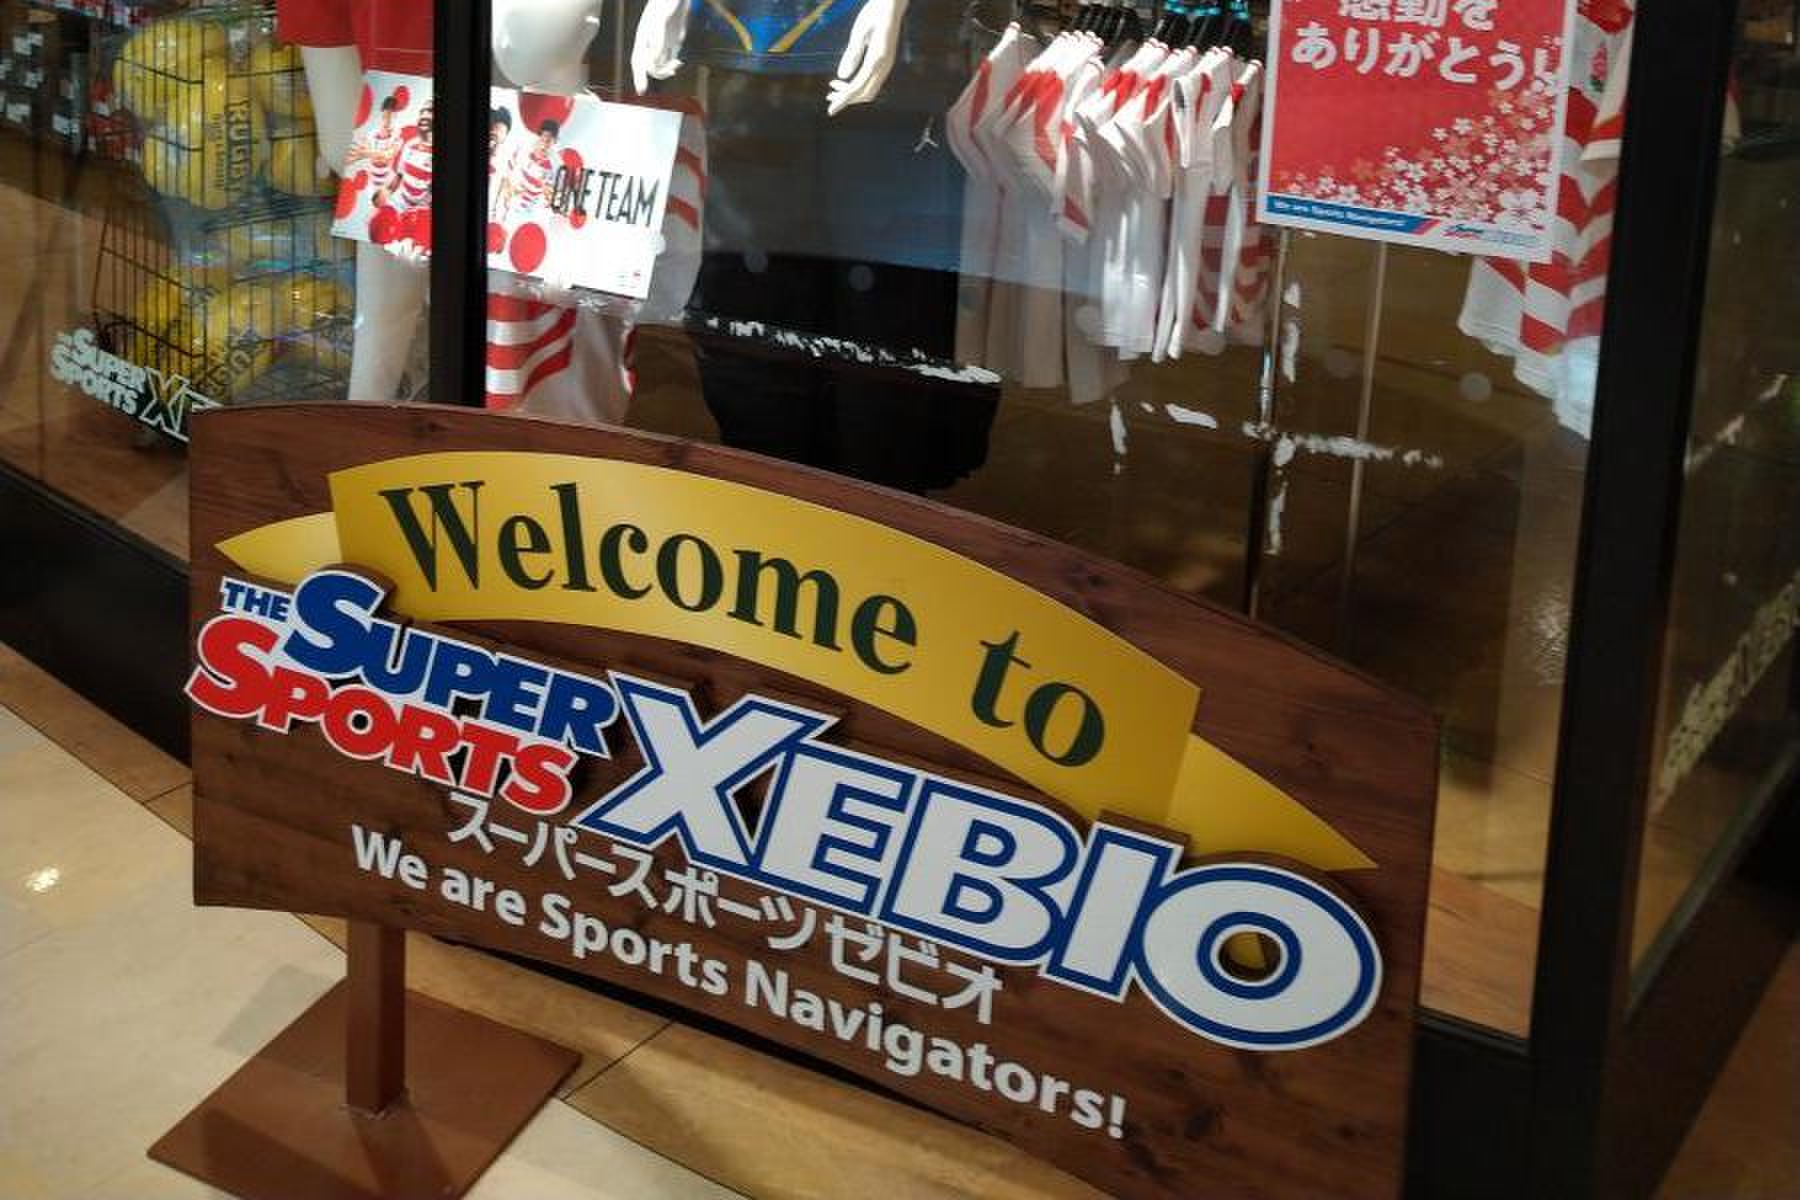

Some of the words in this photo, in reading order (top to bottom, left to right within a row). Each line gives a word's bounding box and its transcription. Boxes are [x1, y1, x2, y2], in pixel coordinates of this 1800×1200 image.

[551, 164, 594, 216] ONE
[595, 170, 660, 227] TEAM
[222, 578, 291, 622] THE
[284, 570, 619, 758] SUPER
[378, 480, 918, 675] Welcome
[970, 630, 1105, 767] to
[185, 615, 578, 815] SPORTS
[574, 671, 1382, 1050] XEBIO
[351, 823, 429, 890] We
[440, 865, 527, 926] are
[538, 892, 730, 996] Sports
[745, 958, 1128, 1140] Navigators!
